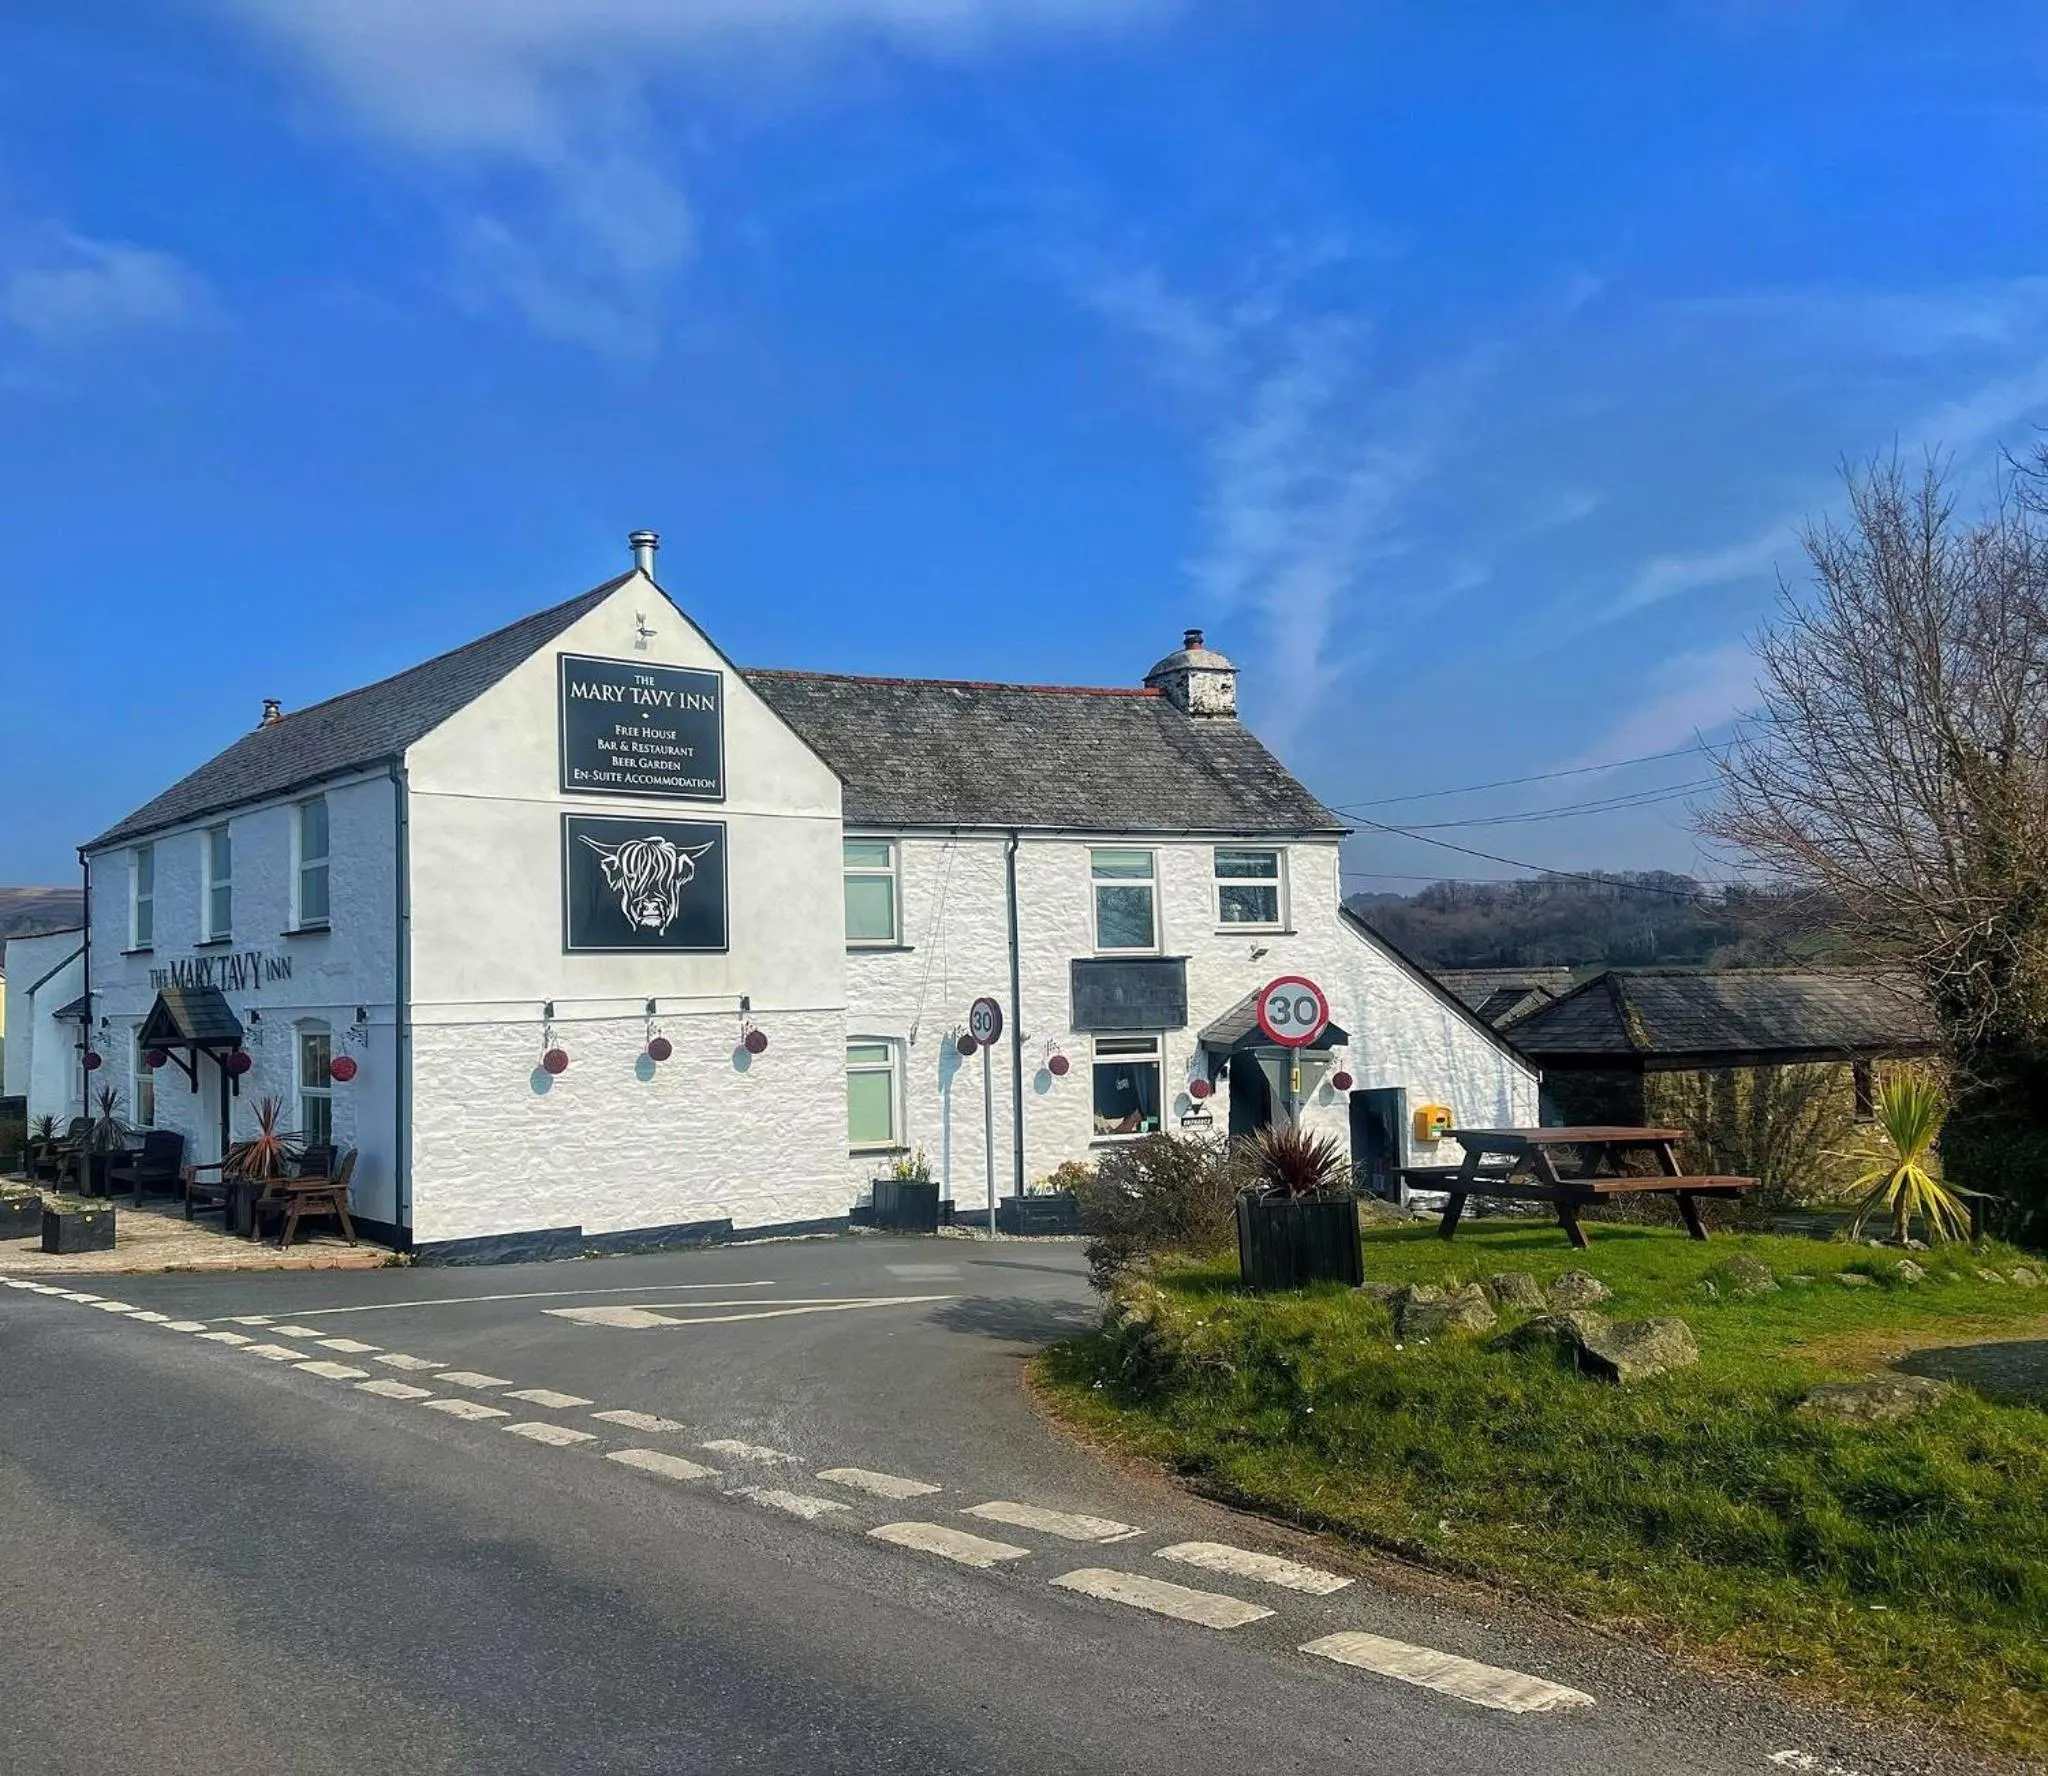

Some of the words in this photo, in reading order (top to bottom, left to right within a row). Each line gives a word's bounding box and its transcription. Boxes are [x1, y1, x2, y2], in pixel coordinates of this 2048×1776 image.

[634, 675, 654, 686] THE
[570, 681, 625, 702] MARY
[629, 687, 675, 707] TAVY
[680, 692, 715, 711] INN
[615, 724, 639, 737] FREE
[642, 727, 676, 740] HOUSE
[597, 739, 618, 750] BAR
[620, 741, 629, 752] &
[631, 742, 694, 757] RESTAURANT
[639, 758, 681, 771] GARDEN
[624, 774, 715, 789] ACCOMMODATION
[148, 969, 167, 989] THE
[169, 956, 215, 989] MARY
[217, 952, 262, 992] TAVY
[265, 956, 292, 981] INN
[1269, 996, 1318, 1025] 30
[974, 1011, 992, 1032] 30
